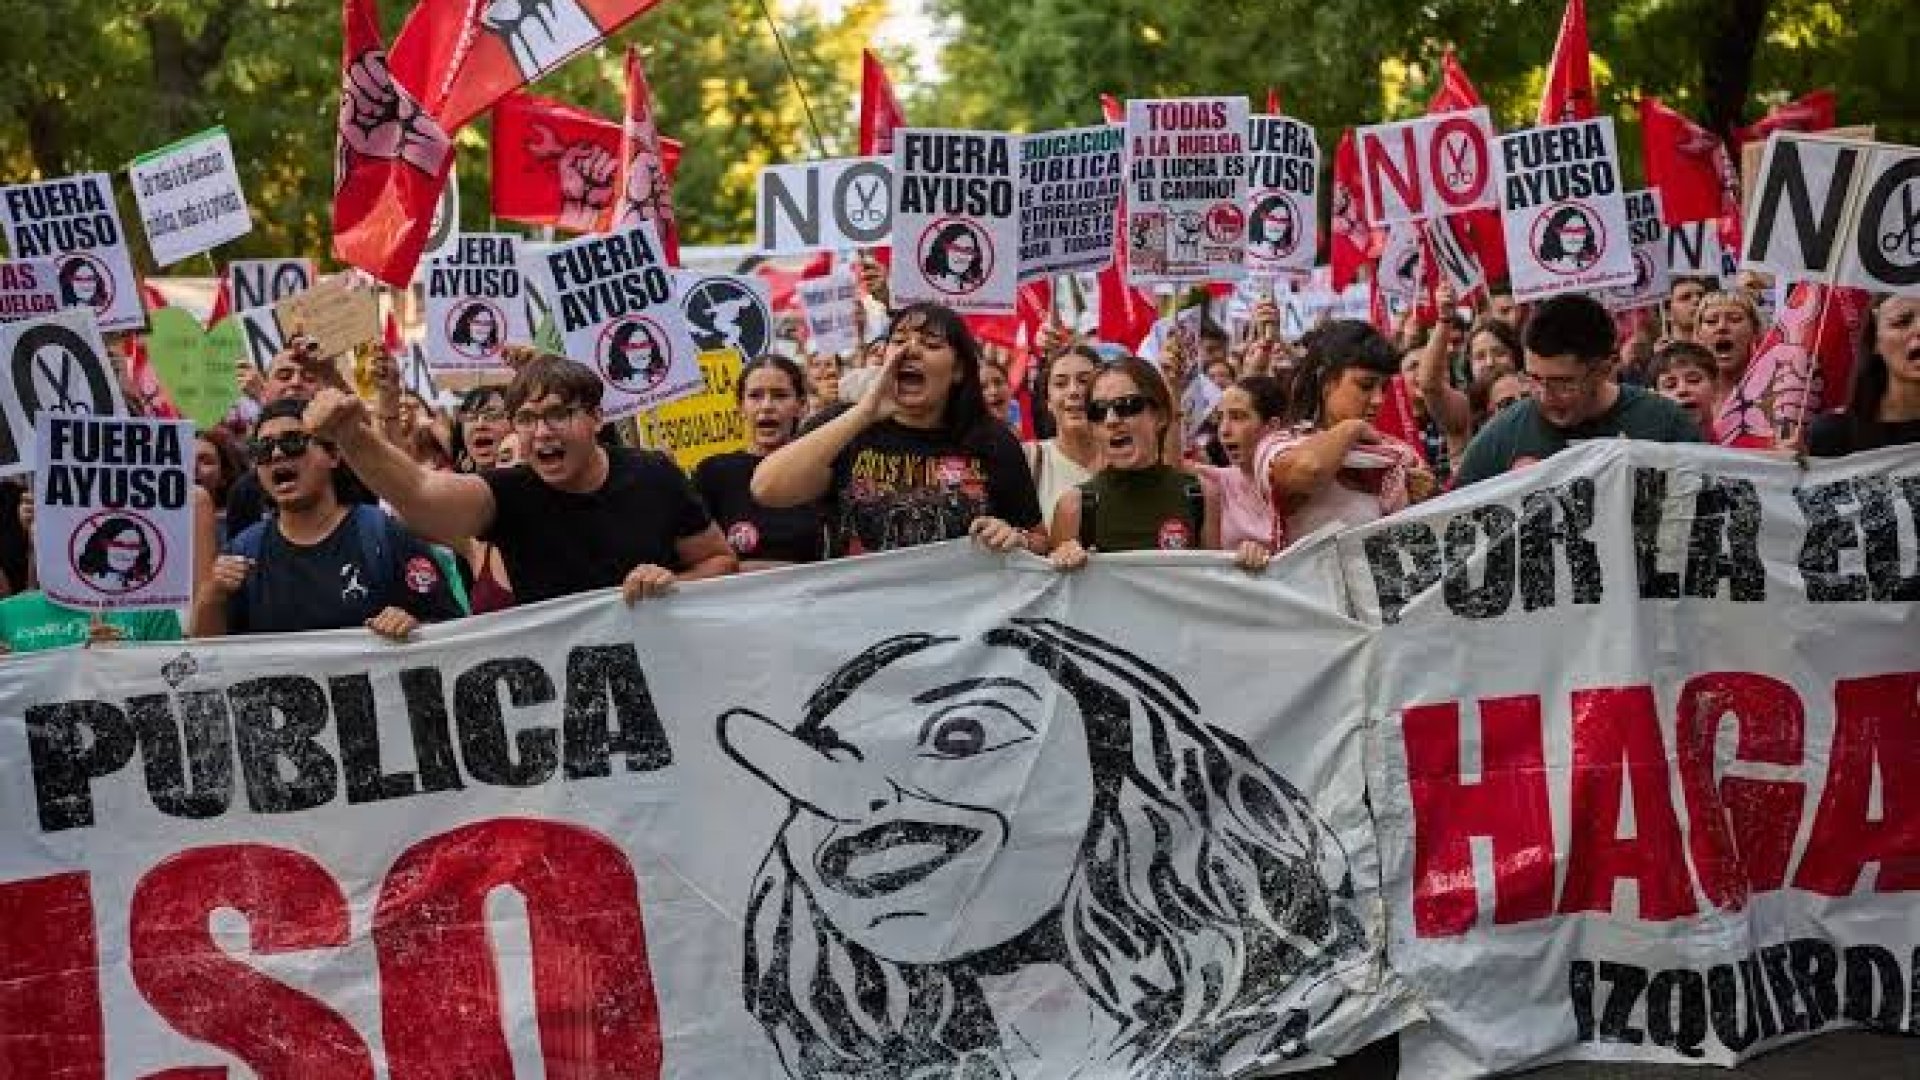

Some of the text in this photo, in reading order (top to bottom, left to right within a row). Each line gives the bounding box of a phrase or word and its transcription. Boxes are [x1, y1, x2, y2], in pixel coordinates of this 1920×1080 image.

[1147, 102, 1227, 131] TODAS
[905, 133, 1010, 176] FUERA
[1132, 133, 1242, 157] A LA HUELGA
[1162, 157, 1218, 179] LUCHA
[1223, 156, 1245, 177] ES
[1501, 123, 1606, 174] FUERA
[1138, 179, 1236, 202] EL CAMINO!
[1363, 117, 1489, 222] NO
[1506, 161, 1615, 211] AYUSO
[5, 176, 107, 224] FUERA
[763, 163, 892, 250] NO
[899, 175, 1014, 219] AYUSO
[1019, 189, 1034, 208] E
[1747, 139, 1920, 286] NO
[15, 214, 117, 260] AYUSO
[433, 237, 516, 266] UERA
[548, 227, 656, 293] FUERA
[429, 268, 519, 299] AYUSO
[558, 264, 672, 334] AYUSO
[50, 418, 183, 466] FUERA
[45, 467, 187, 510] AYUSO
[1363, 466, 1920, 626] POR LA ED
[24, 642, 675, 833] PÚBLICA
